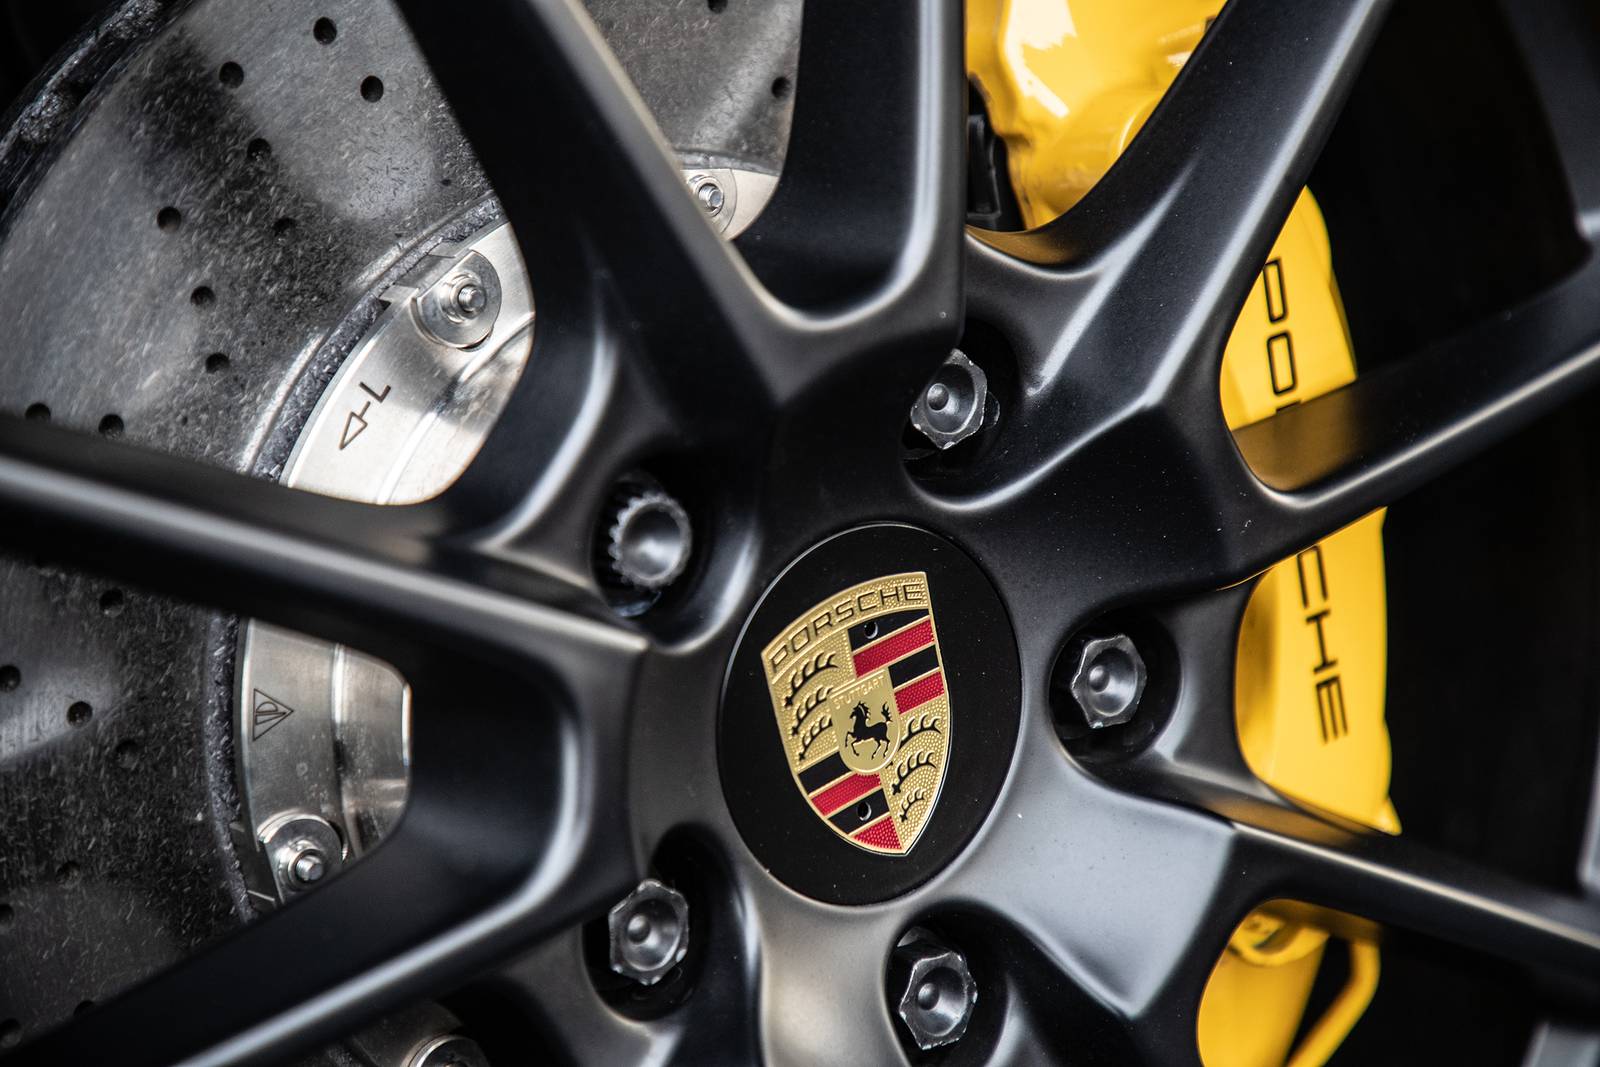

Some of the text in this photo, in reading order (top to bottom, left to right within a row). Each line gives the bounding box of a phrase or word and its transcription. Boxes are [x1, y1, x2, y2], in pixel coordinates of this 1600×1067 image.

[1262, 258, 1348, 744] POCHE
[770, 583, 923, 674] PORSCHE
[832, 675, 885, 710] STUTTGART
